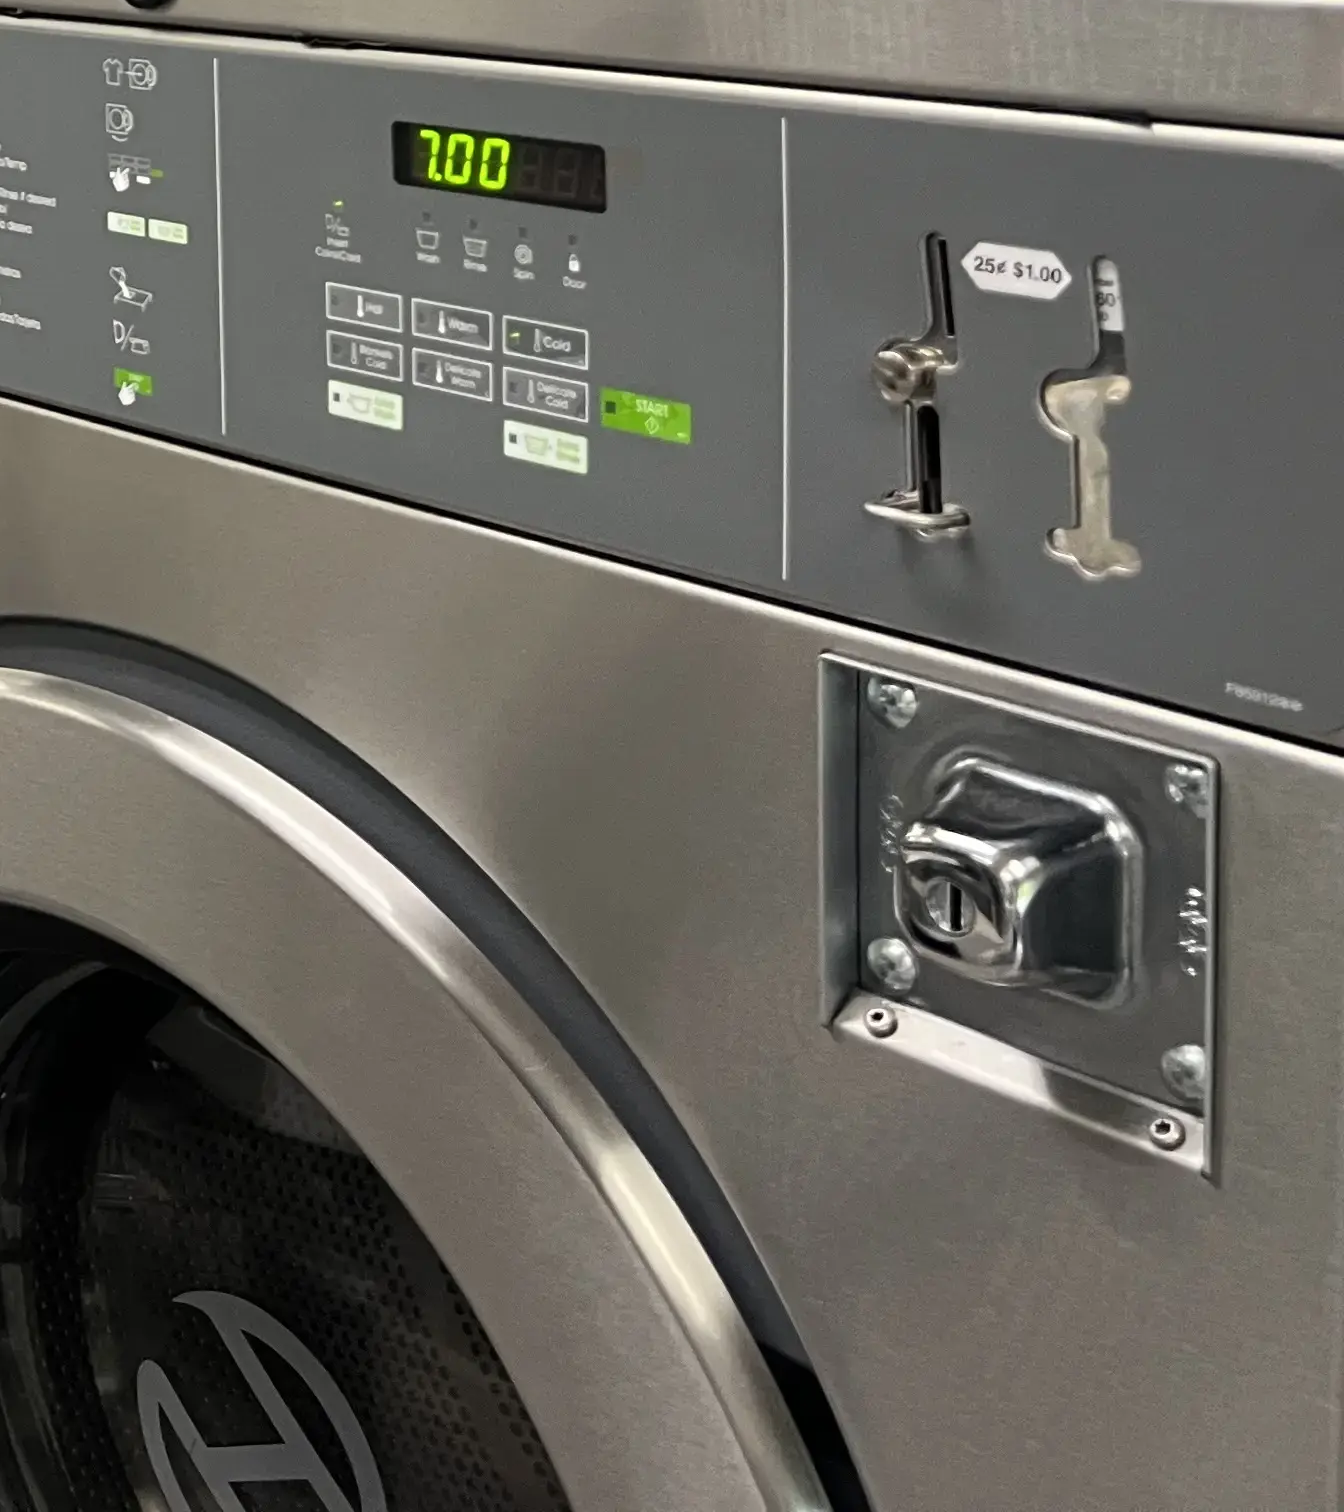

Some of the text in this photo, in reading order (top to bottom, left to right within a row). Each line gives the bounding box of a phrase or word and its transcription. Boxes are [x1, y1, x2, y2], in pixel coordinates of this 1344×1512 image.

[420, 129, 510, 190] 7.00
[973, 255, 1062, 284] 25¢ $1.00
[635, 397, 669, 418] START
